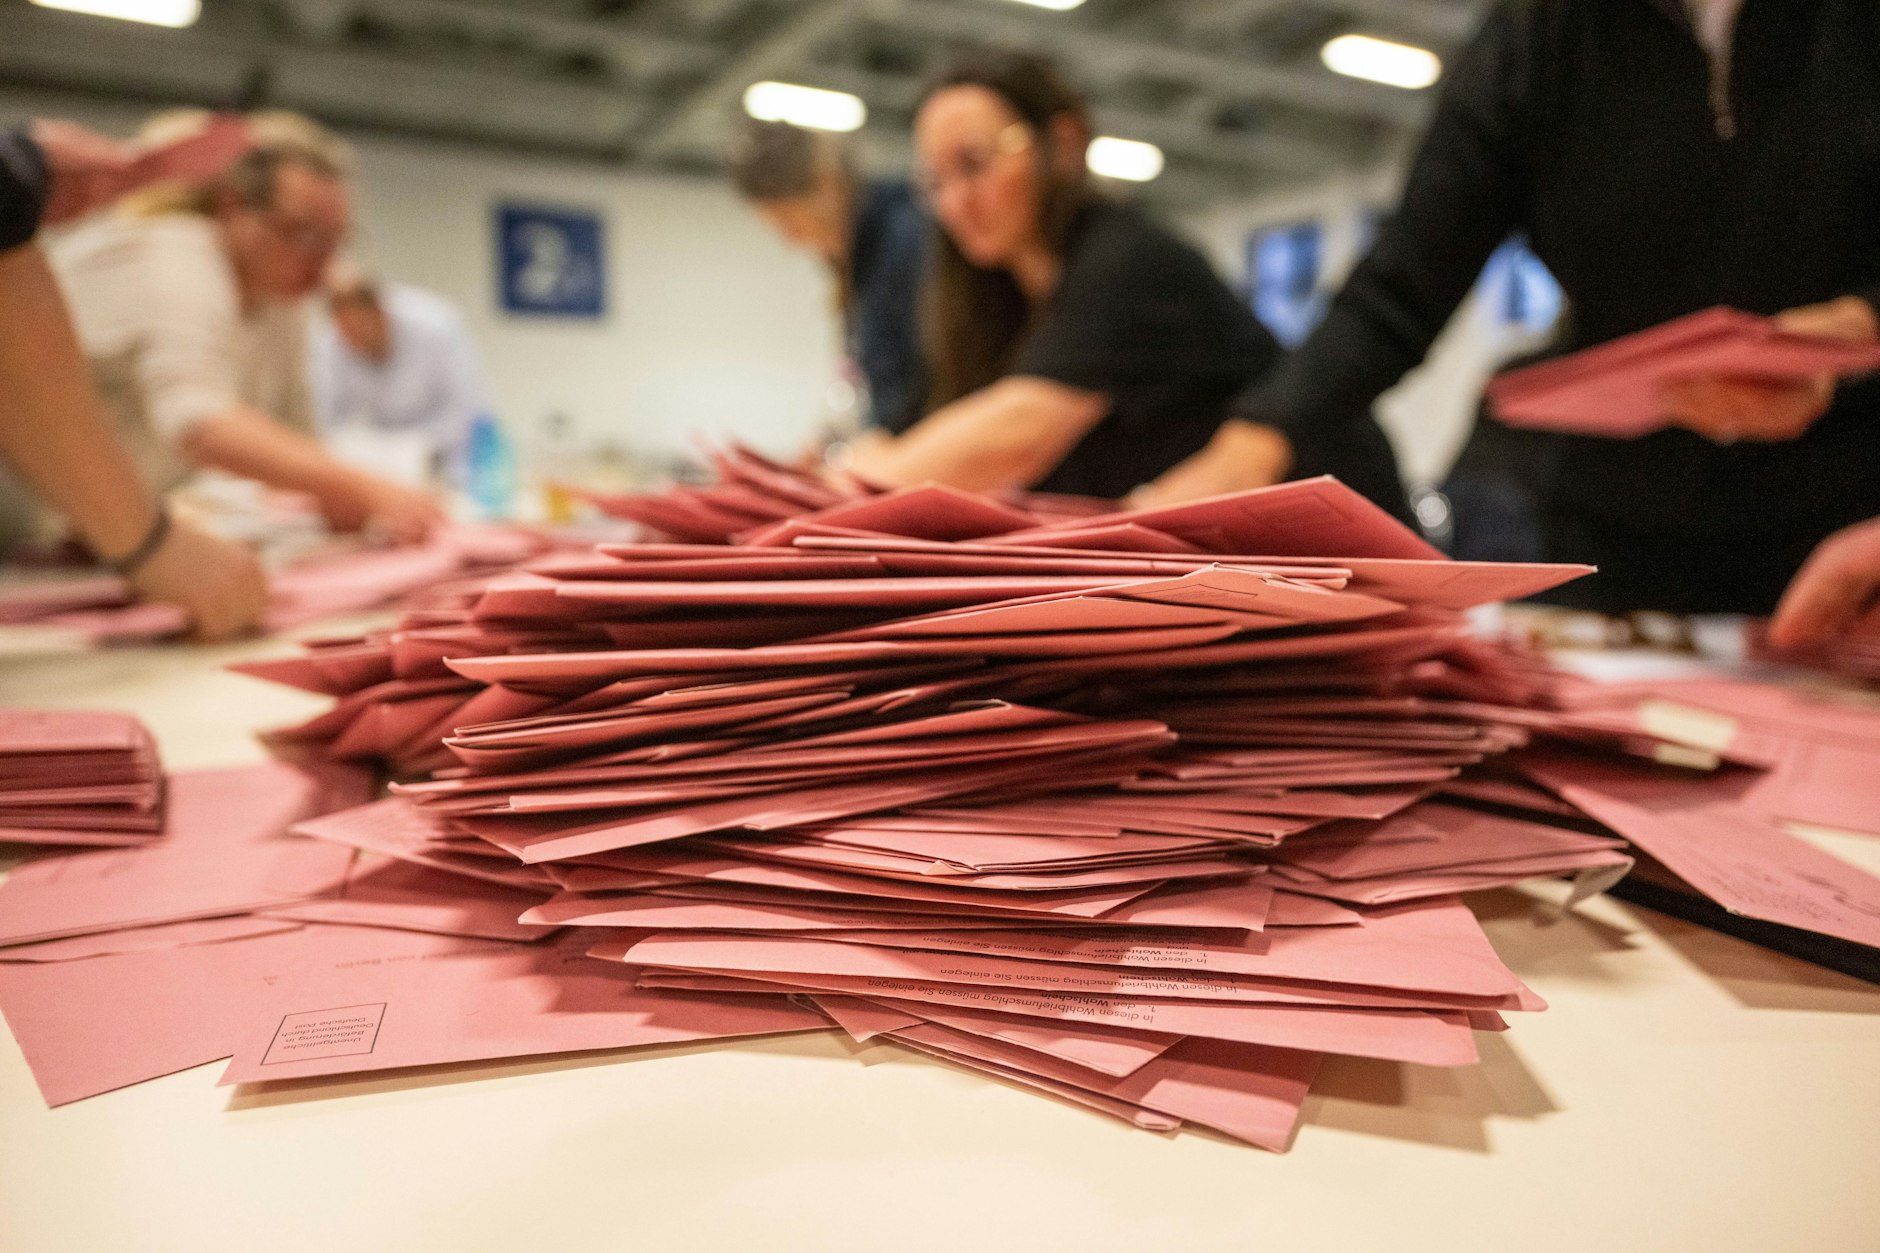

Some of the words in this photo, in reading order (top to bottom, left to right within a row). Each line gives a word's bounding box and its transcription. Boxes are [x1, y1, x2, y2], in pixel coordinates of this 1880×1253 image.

[923, 937, 970, 946] einlegen
[994, 944, 1035, 952] müssen
[1039, 947, 1150, 963] Wahlbriefumschlag
[1153, 956, 1193, 964] diesen
[940, 969, 990, 979] einlegen
[994, 973, 1012, 981] Sie
[1016, 974, 1060, 984] müssen
[1118, 975, 1188, 983] Wahlschein
[867, 979, 915, 992] einlegen
[1063, 977, 1180, 991] Wahlbriefumschlag
[1182, 984, 1222, 993] diesen
[917, 986, 936, 996] Sie
[938, 988, 980, 1000] müssen
[984, 993, 1096, 1016] Wahlbriefumschlag
[1041, 993, 1110, 1007] Wahlschein
[1113, 1001, 1136, 1010] den
[1148, 1005, 1156, 1013] 1.
[1099, 1009, 1140, 1021] diesen
[1143, 1014, 1154, 1023] In
[294, 1022, 316, 1030] Post
[319, 1017, 366, 1027] Deutsche
[311, 1022, 374, 1034] Deutschland
[281, 1029, 310, 1038] durch
[298, 1030, 365, 1041] Beförderung
[283, 1037, 361, 1050] Unentgeltliche
